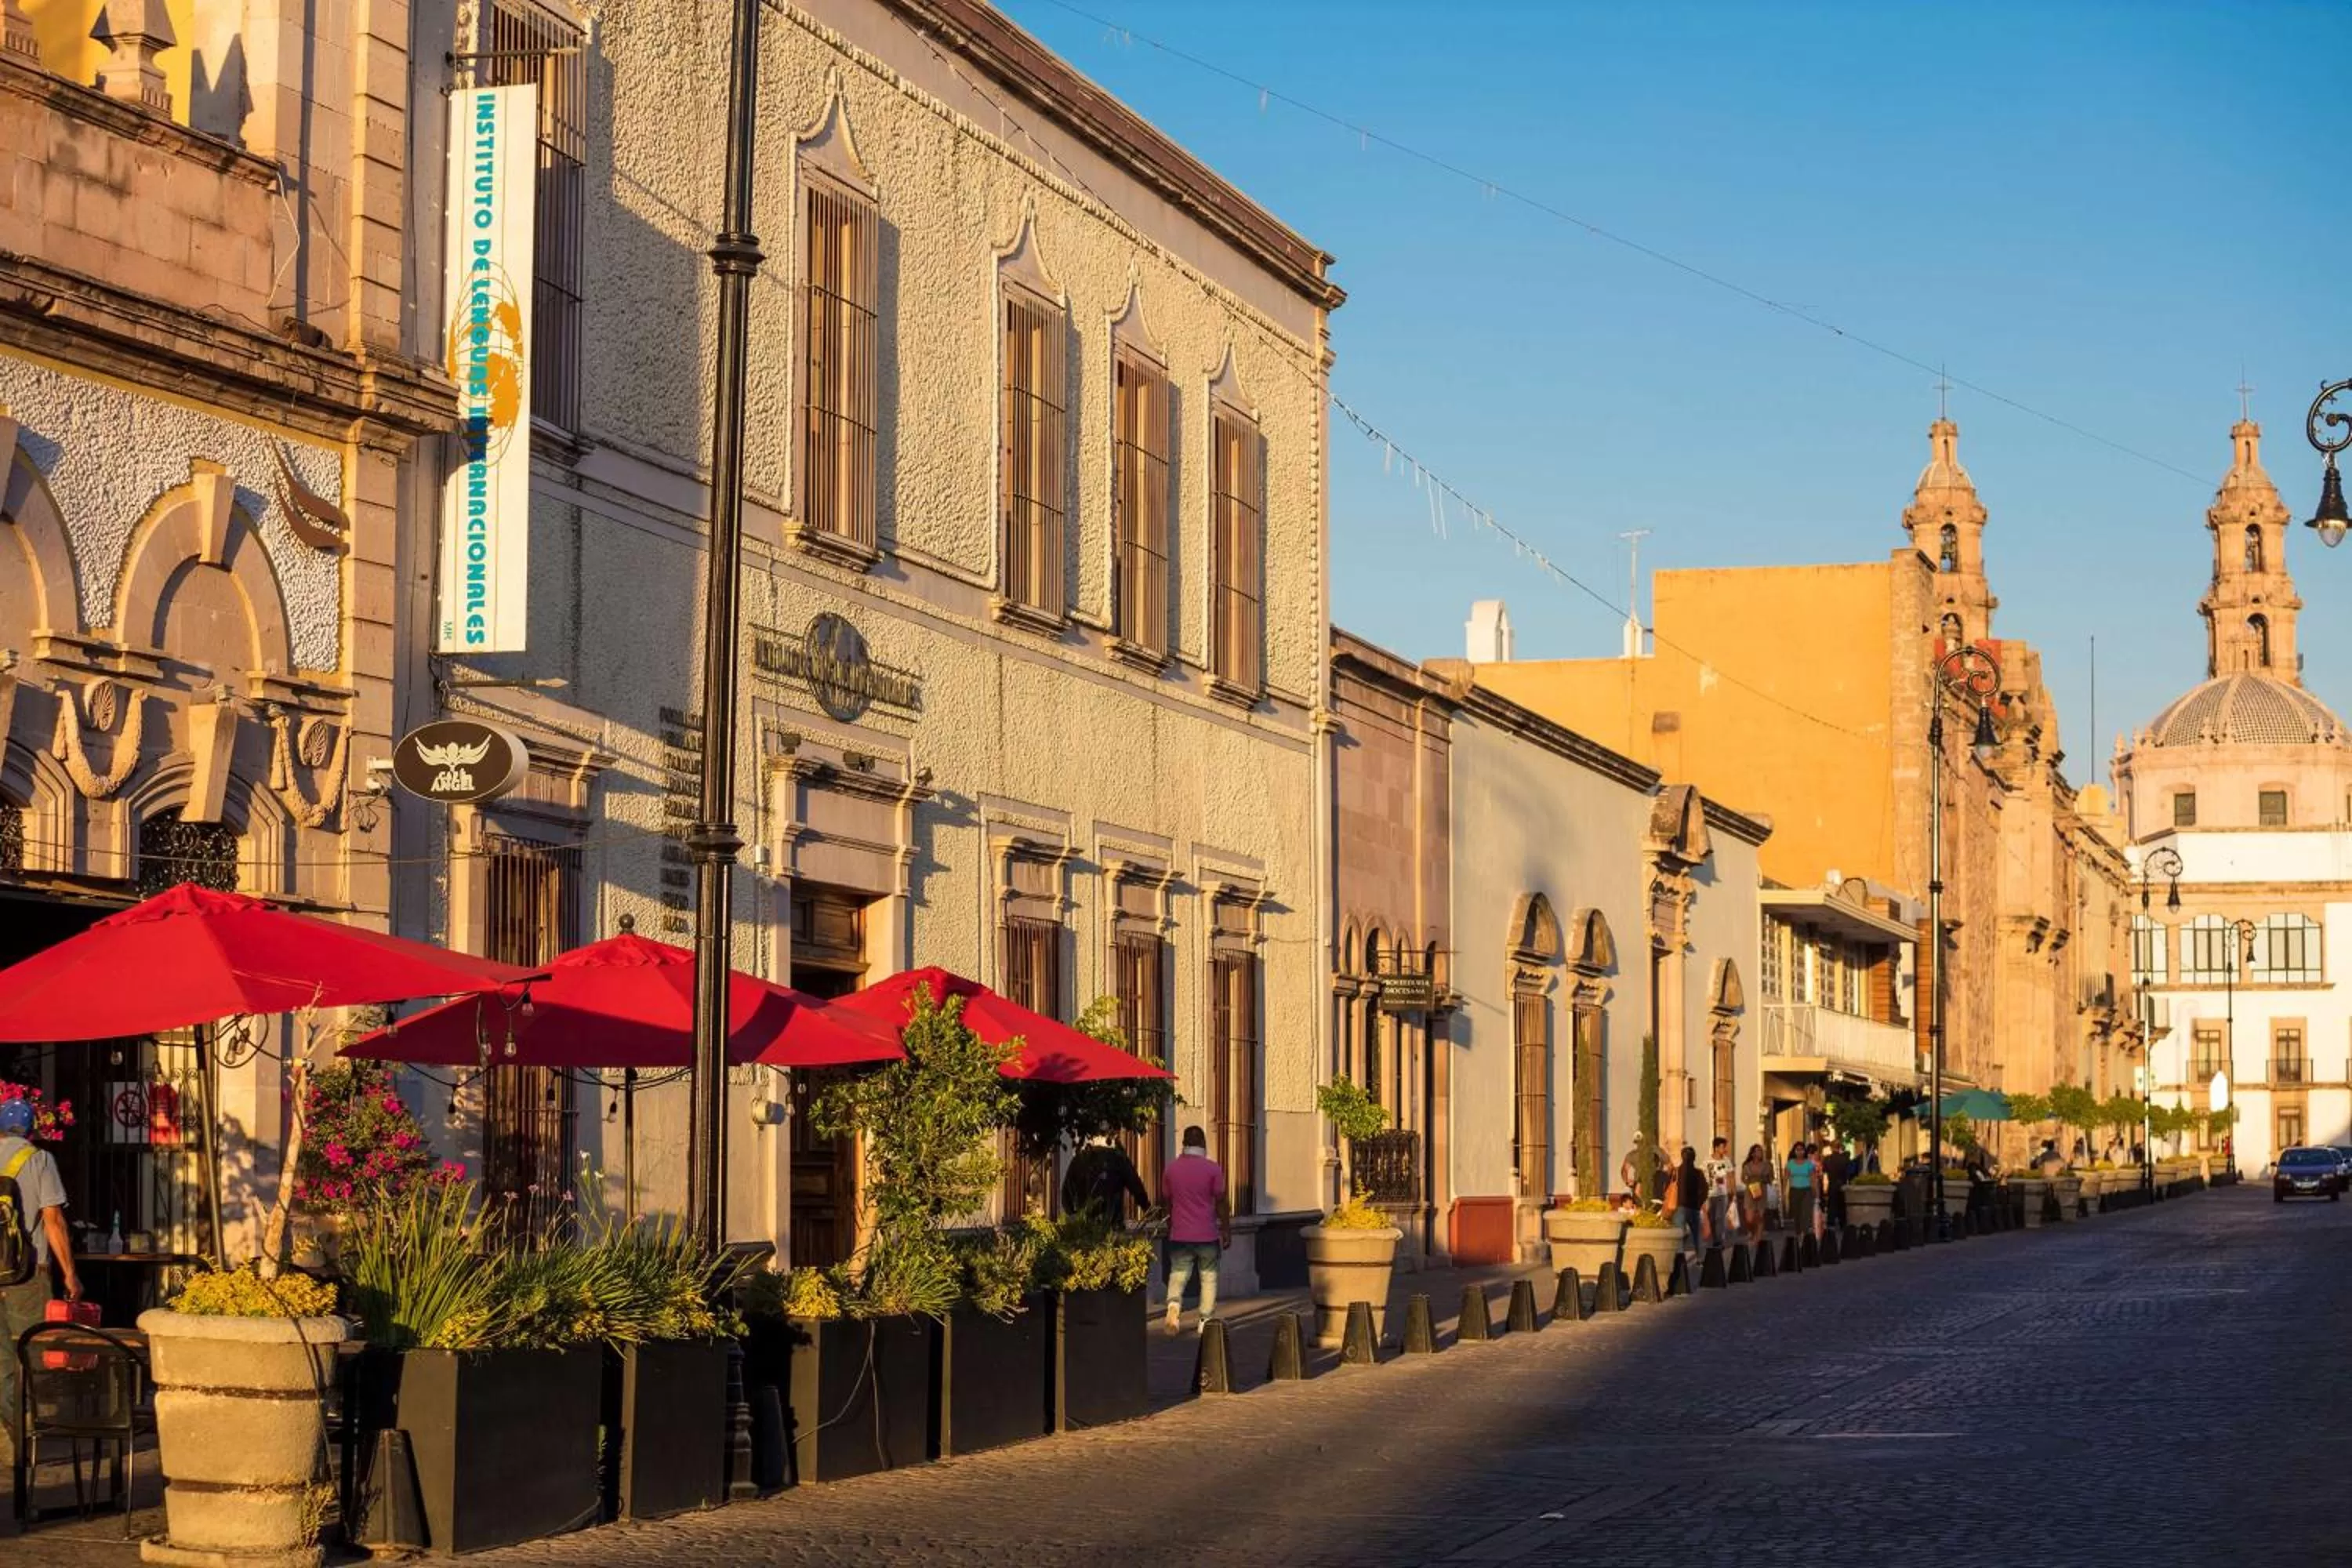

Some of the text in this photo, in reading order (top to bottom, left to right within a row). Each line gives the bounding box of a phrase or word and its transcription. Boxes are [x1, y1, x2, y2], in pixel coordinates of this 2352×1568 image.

[474, 93, 495, 229] INSTITUTO
[471, 239, 492, 271] DE
[470, 281, 490, 398] LENGUAS
